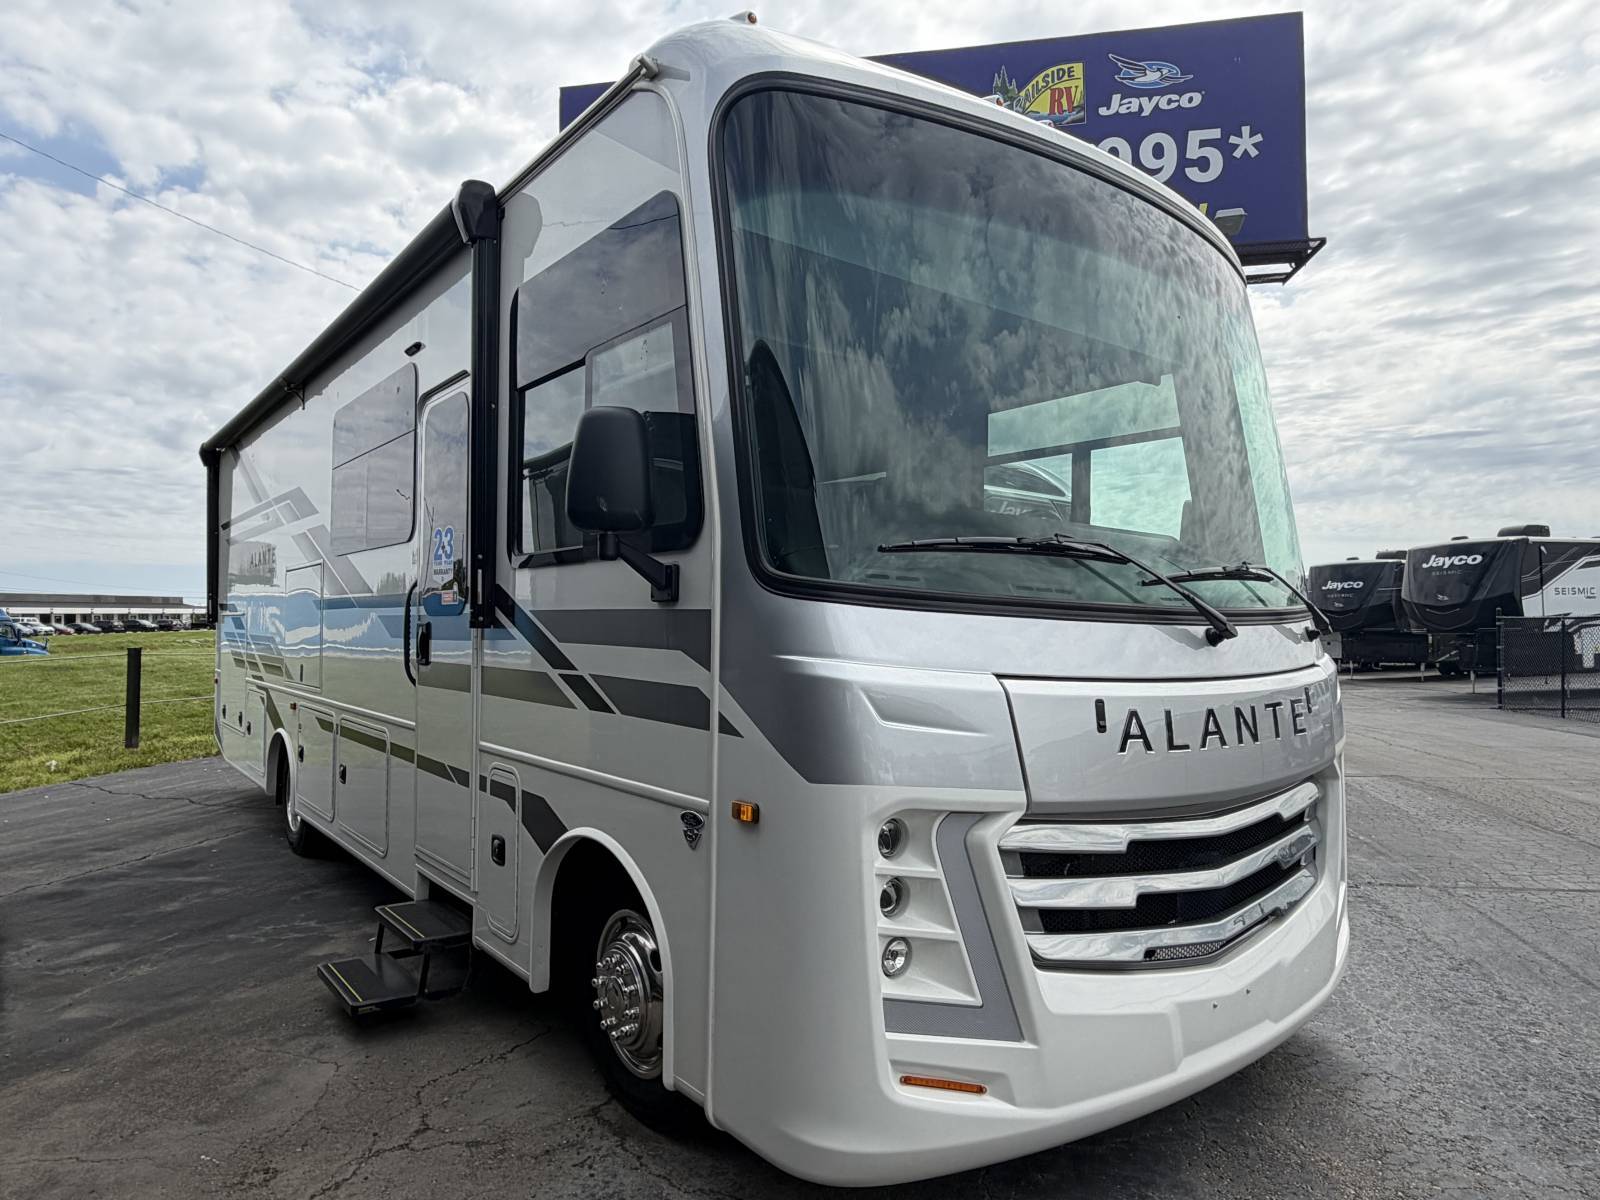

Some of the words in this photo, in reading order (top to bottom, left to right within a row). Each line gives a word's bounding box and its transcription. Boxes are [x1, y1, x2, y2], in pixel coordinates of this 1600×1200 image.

[1004, 66, 1075, 113] RAILSIDE
[1048, 85, 1079, 116] RV
[1098, 91, 1202, 116] Jayco
[1422, 554, 1483, 569] Jayco
[1321, 580, 1364, 591] Jayco
[1554, 587, 1596, 596] SEISMIC
[1118, 698, 1308, 755] ALANTE
